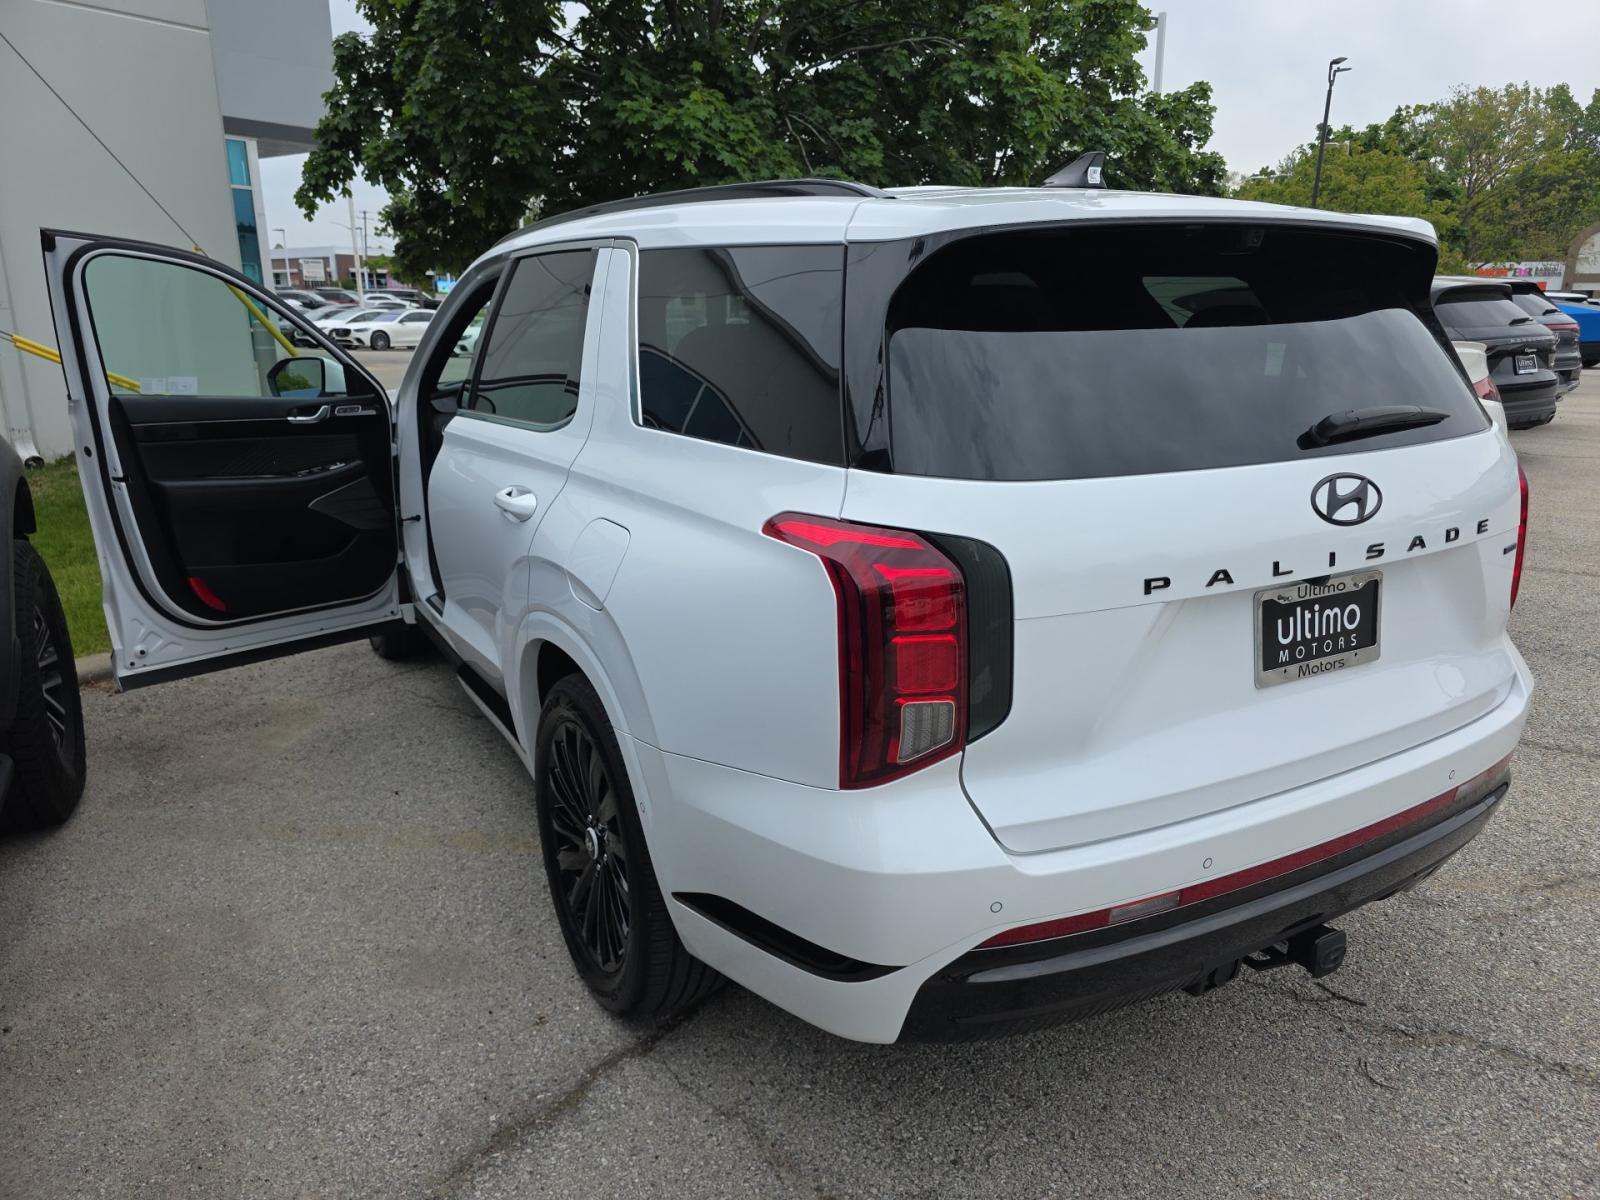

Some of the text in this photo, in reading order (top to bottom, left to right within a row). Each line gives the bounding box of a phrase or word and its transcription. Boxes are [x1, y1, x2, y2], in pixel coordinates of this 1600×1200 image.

[1143, 519, 1490, 595] PALISADE
[1297, 582, 1346, 599] Ultimo
[1277, 604, 1361, 645] ultimo
[1278, 633, 1357, 663] MOTORS
[1297, 658, 1345, 678] Motors
